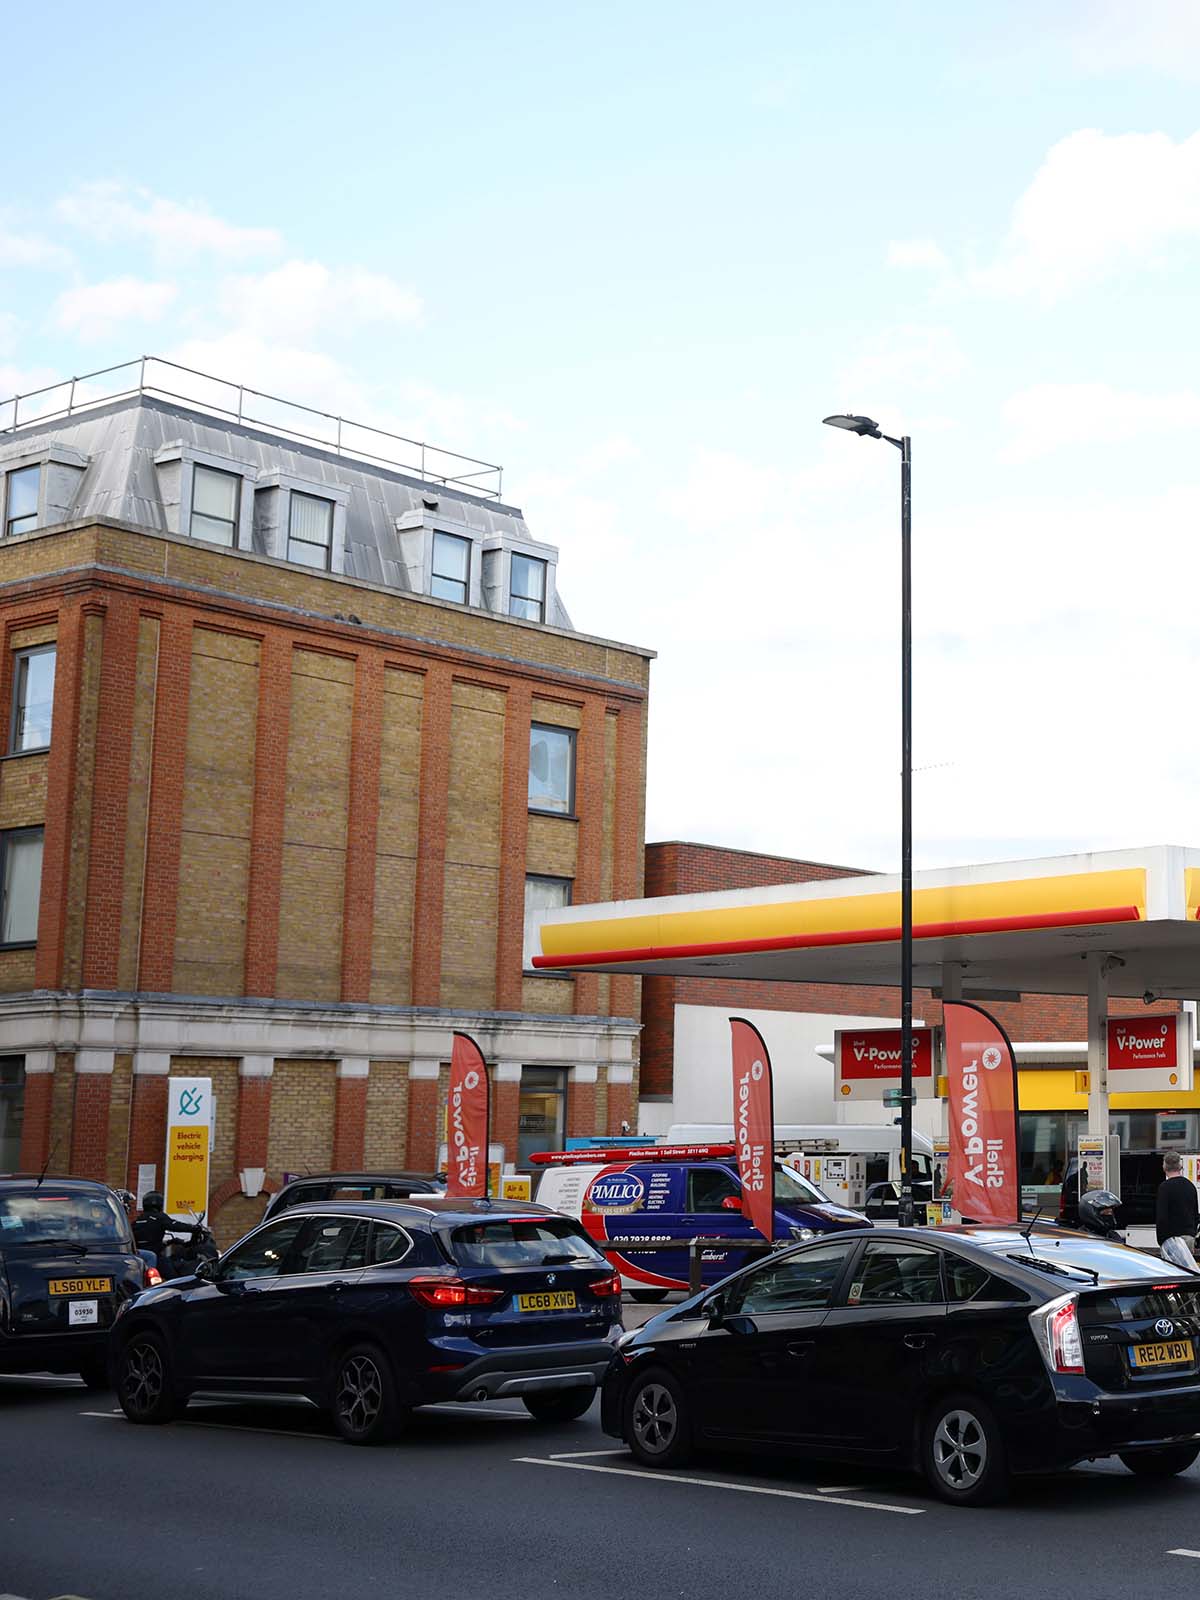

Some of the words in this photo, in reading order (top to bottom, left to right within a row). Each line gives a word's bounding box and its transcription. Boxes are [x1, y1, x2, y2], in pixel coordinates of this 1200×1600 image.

[1117, 1035, 1166, 1051] V-Power
[853, 1047, 917, 1061] V-Powr
[177, 1132, 202, 1140] Electric
[173, 1153, 204, 1162] charging
[507, 1184, 517, 1192] Air
[589, 1184, 641, 1199] PIMLICO
[54, 1280, 83, 1293] LS60
[85, 1279, 105, 1292] YLF
[520, 1295, 551, 1309] LC68
[552, 1293, 574, 1307] XWG
[1139, 1345, 1166, 1363] RE12
[1167, 1343, 1189, 1361] WBV
